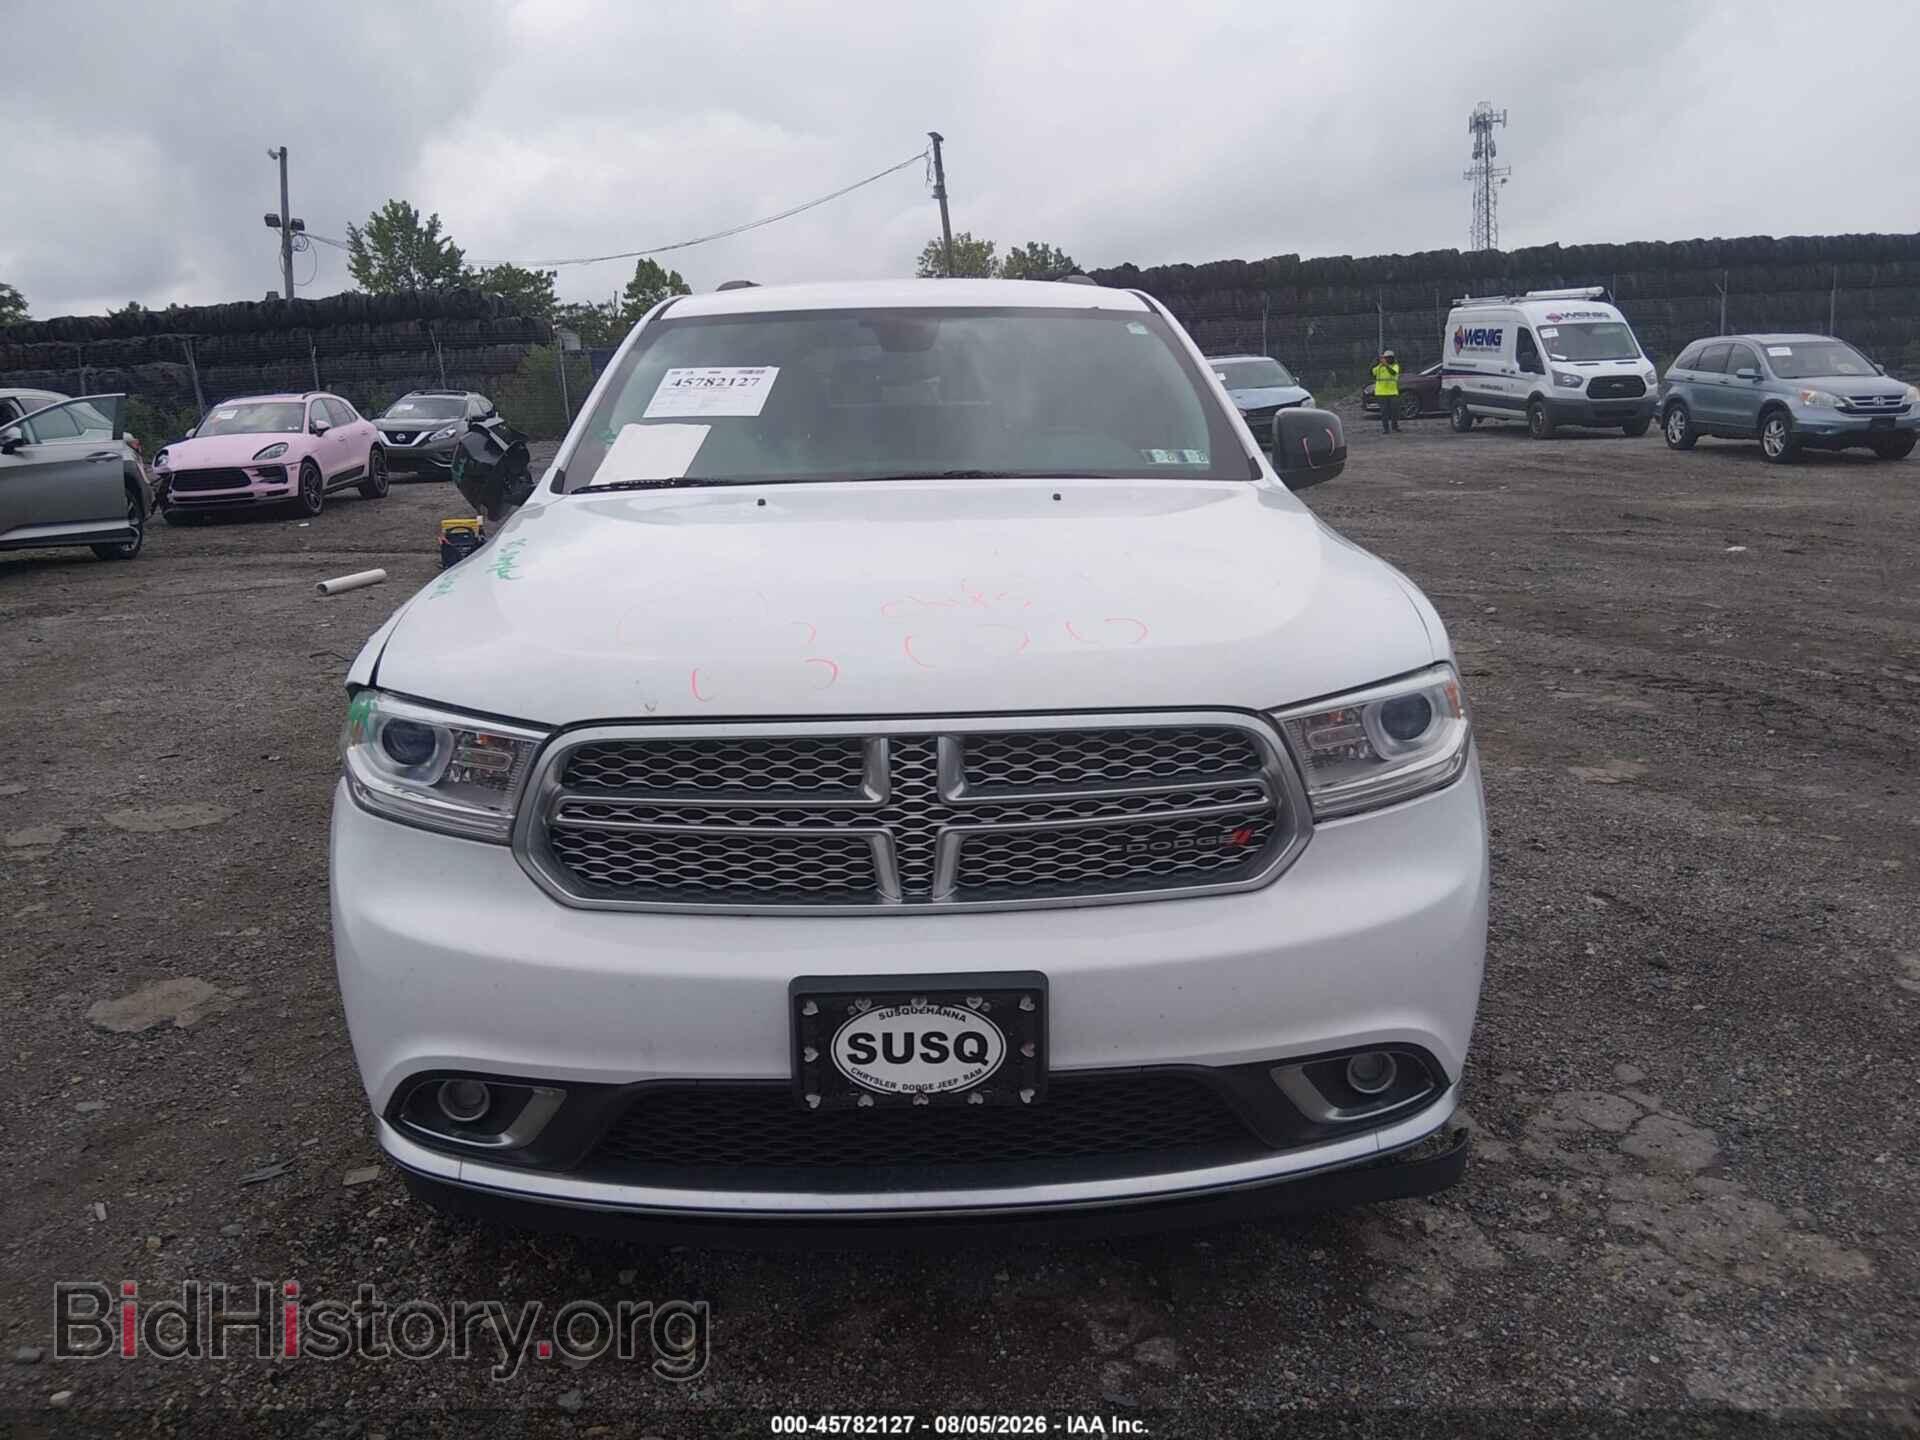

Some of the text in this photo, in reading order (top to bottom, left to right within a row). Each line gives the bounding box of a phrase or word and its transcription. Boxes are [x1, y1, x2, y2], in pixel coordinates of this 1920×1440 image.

[1464, 328, 1503, 346] WENIG
[672, 377, 760, 387] 45782127
[1126, 836, 1234, 852] DODGE
[878, 1006, 967, 1022] SUSQUEHANNA
[847, 1031, 989, 1066] SUSQ
[850, 1067, 983, 1092] CHRYSLER DODGE JEEP RAM
